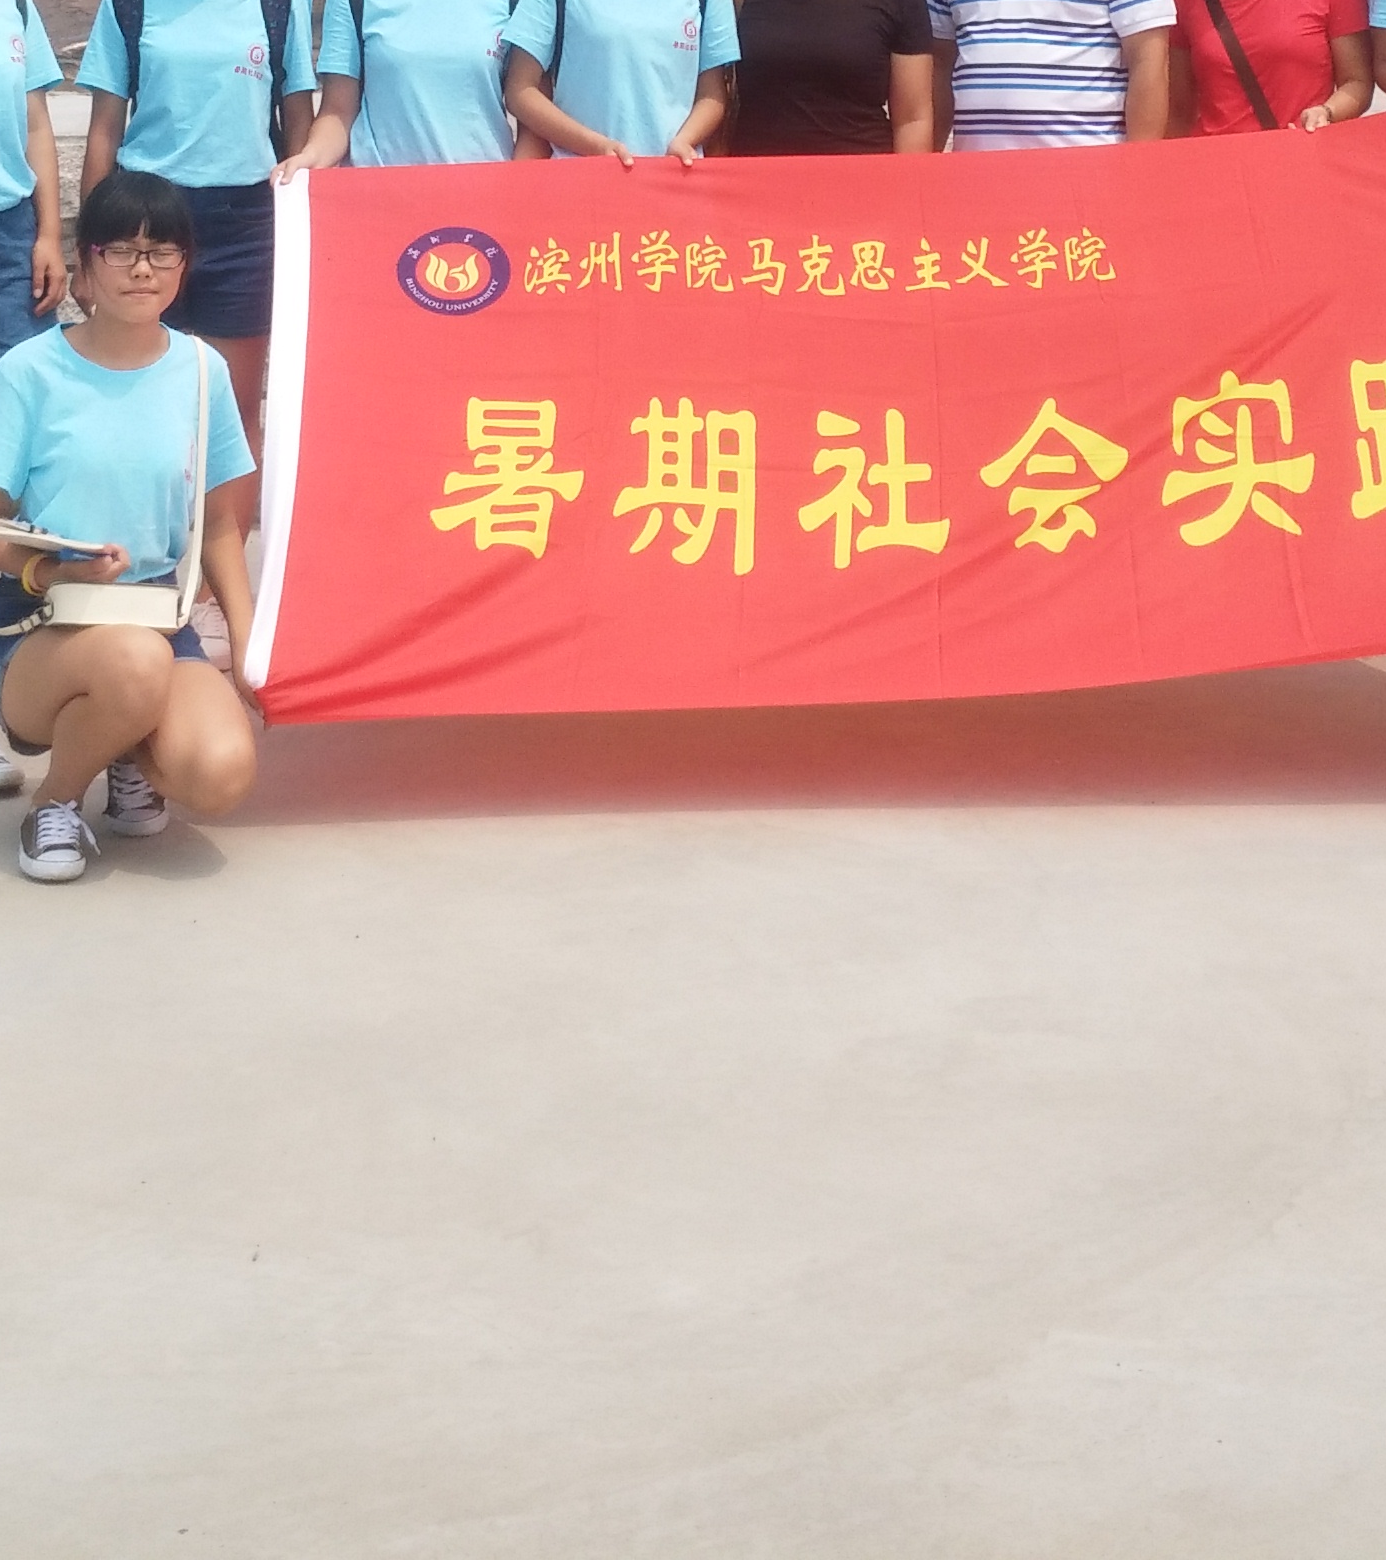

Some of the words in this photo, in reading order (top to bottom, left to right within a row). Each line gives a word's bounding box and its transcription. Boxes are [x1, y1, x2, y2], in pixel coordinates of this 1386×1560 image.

[523, 226, 1117, 296] 滨州学院马克思主义学院
[405, 277, 445, 310] BINZHOU
[445, 278, 499, 311] UNIVERSITY
